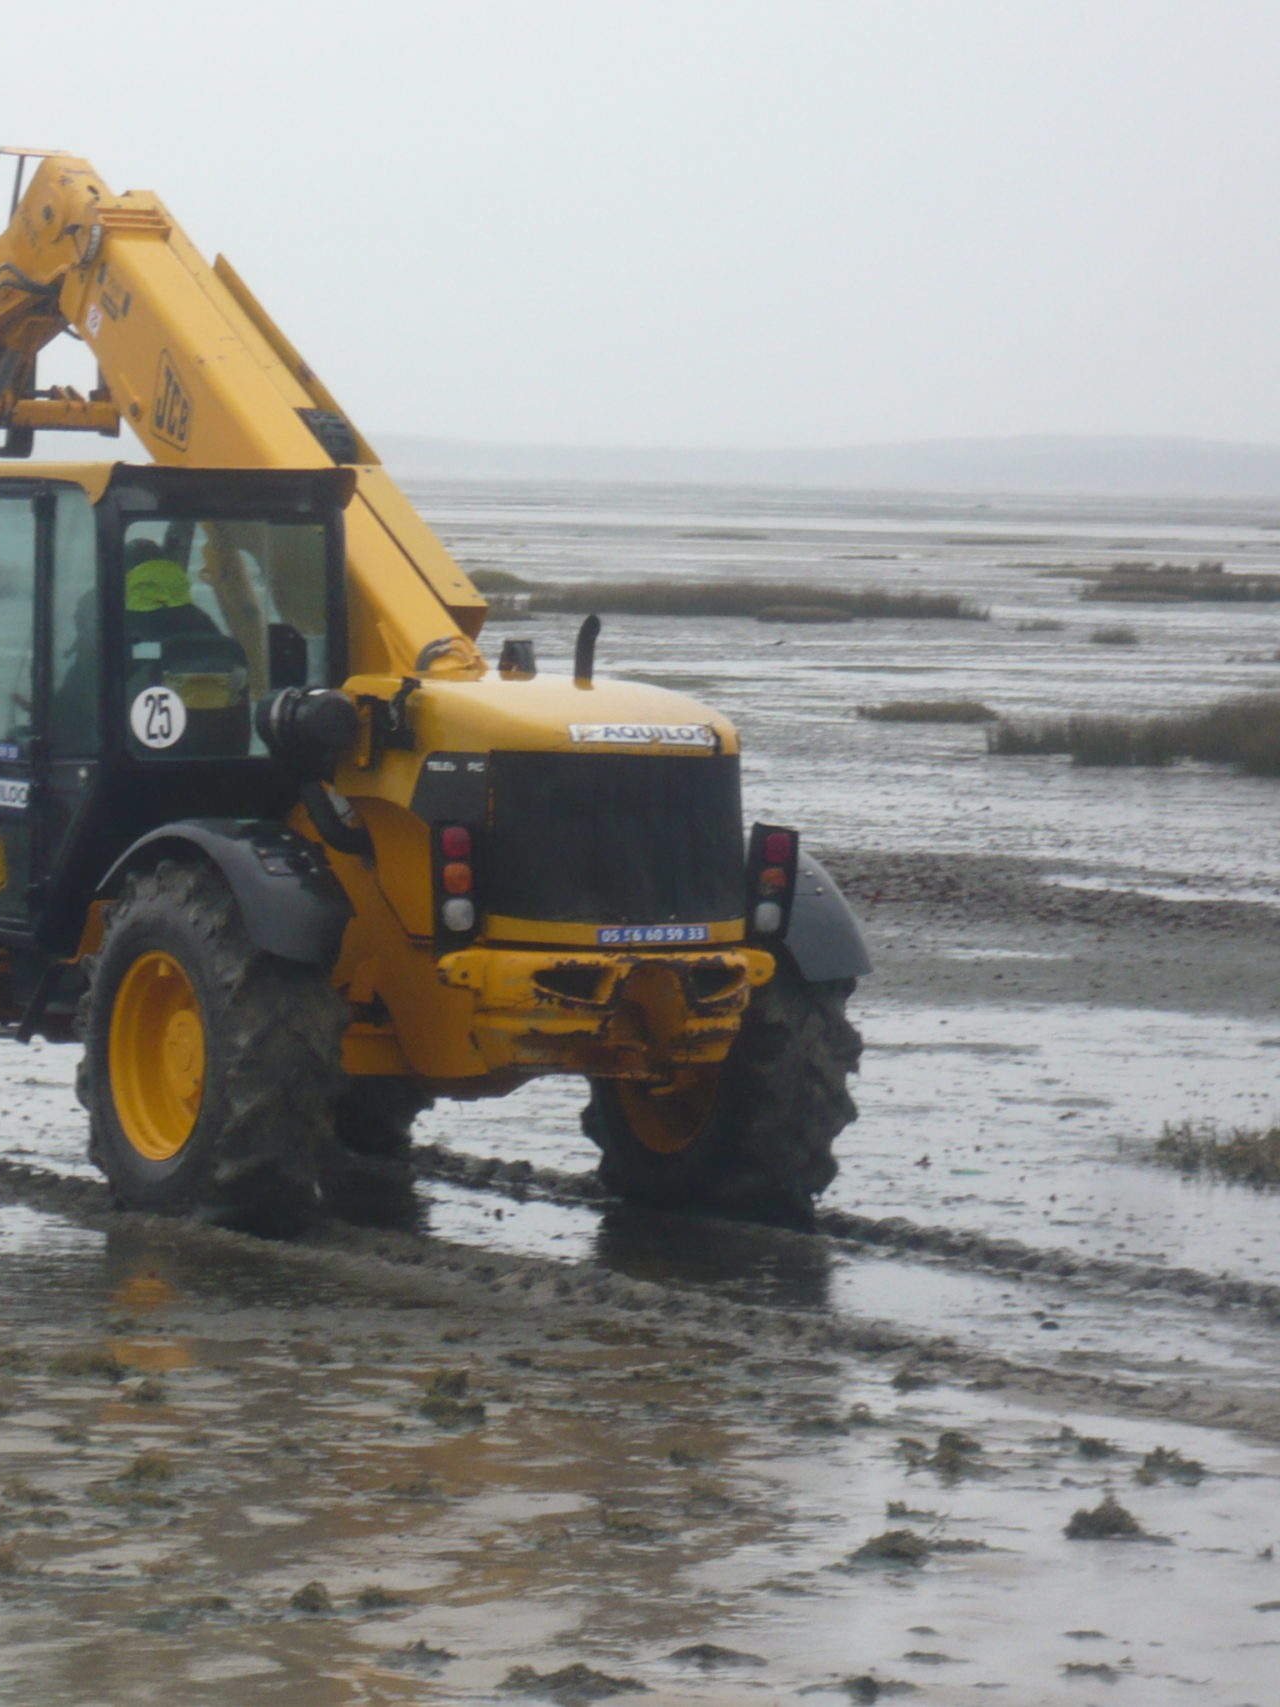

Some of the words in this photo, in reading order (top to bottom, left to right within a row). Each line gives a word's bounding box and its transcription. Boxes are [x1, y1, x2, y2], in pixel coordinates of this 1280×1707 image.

[155, 364, 189, 442] JCB
[144, 693, 172, 740] 25
[600, 929, 621, 943] 05
[645, 927, 665, 941] 60
[665, 927, 685, 941] 59
[687, 926, 706, 940] 33
